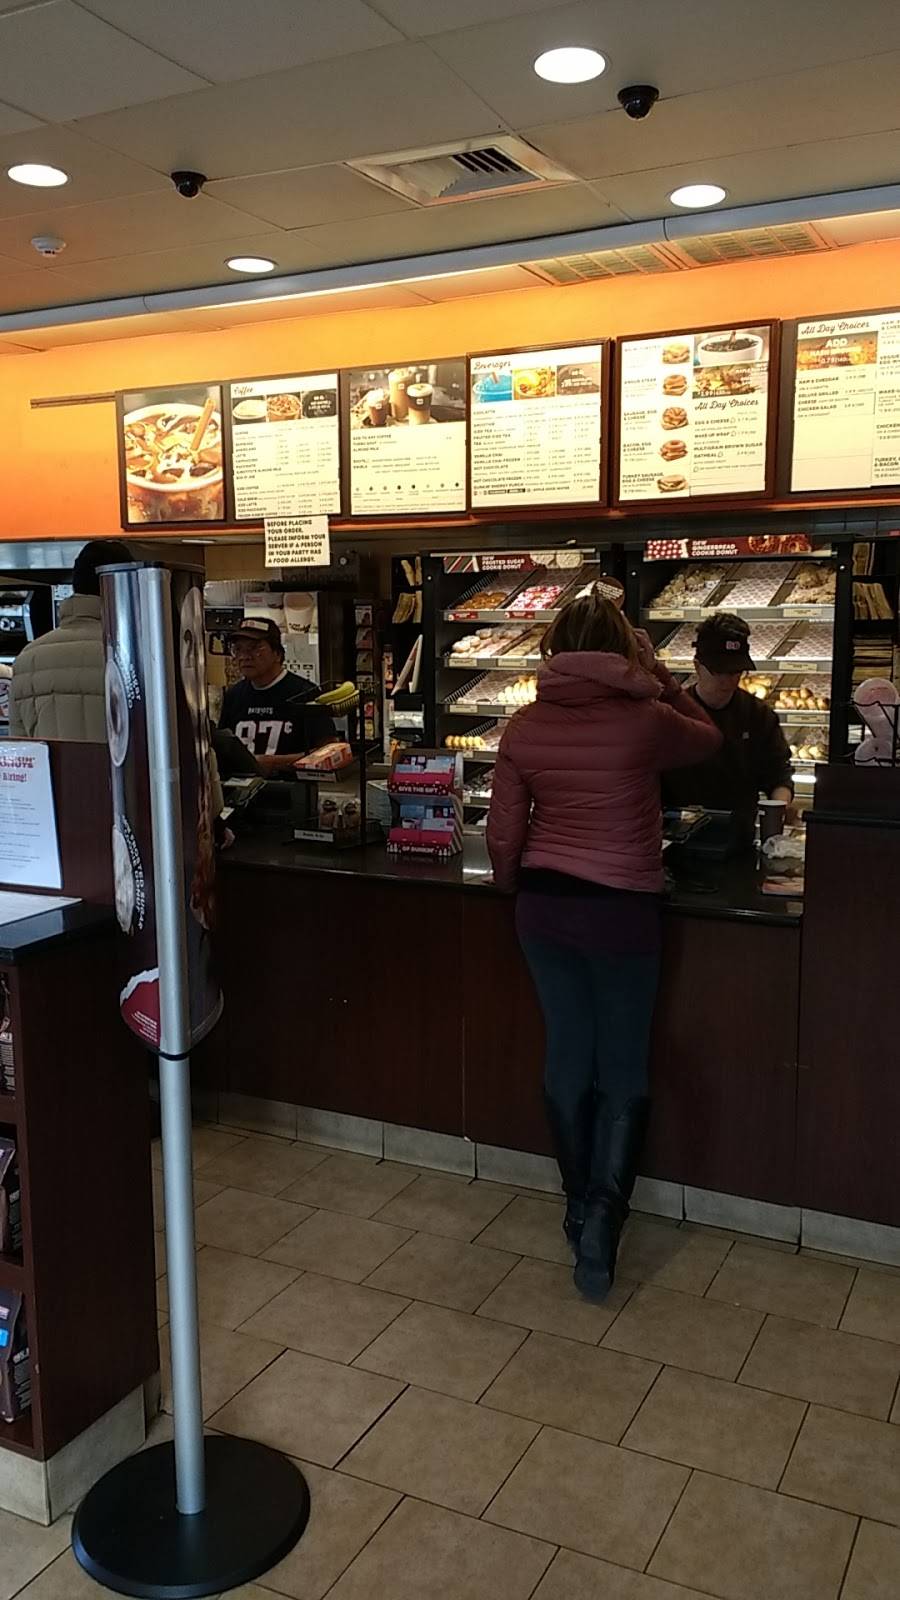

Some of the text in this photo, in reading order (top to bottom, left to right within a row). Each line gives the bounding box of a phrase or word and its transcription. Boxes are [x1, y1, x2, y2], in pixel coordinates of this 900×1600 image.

[801, 322, 869, 335] All Day Choices
[825, 338, 848, 348] ADD
[474, 361, 511, 371] Beverages
[234, 386, 253, 395] Coffee
[695, 399, 759, 410] All Day Choices
[131, 834, 145, 887] FROSTED
